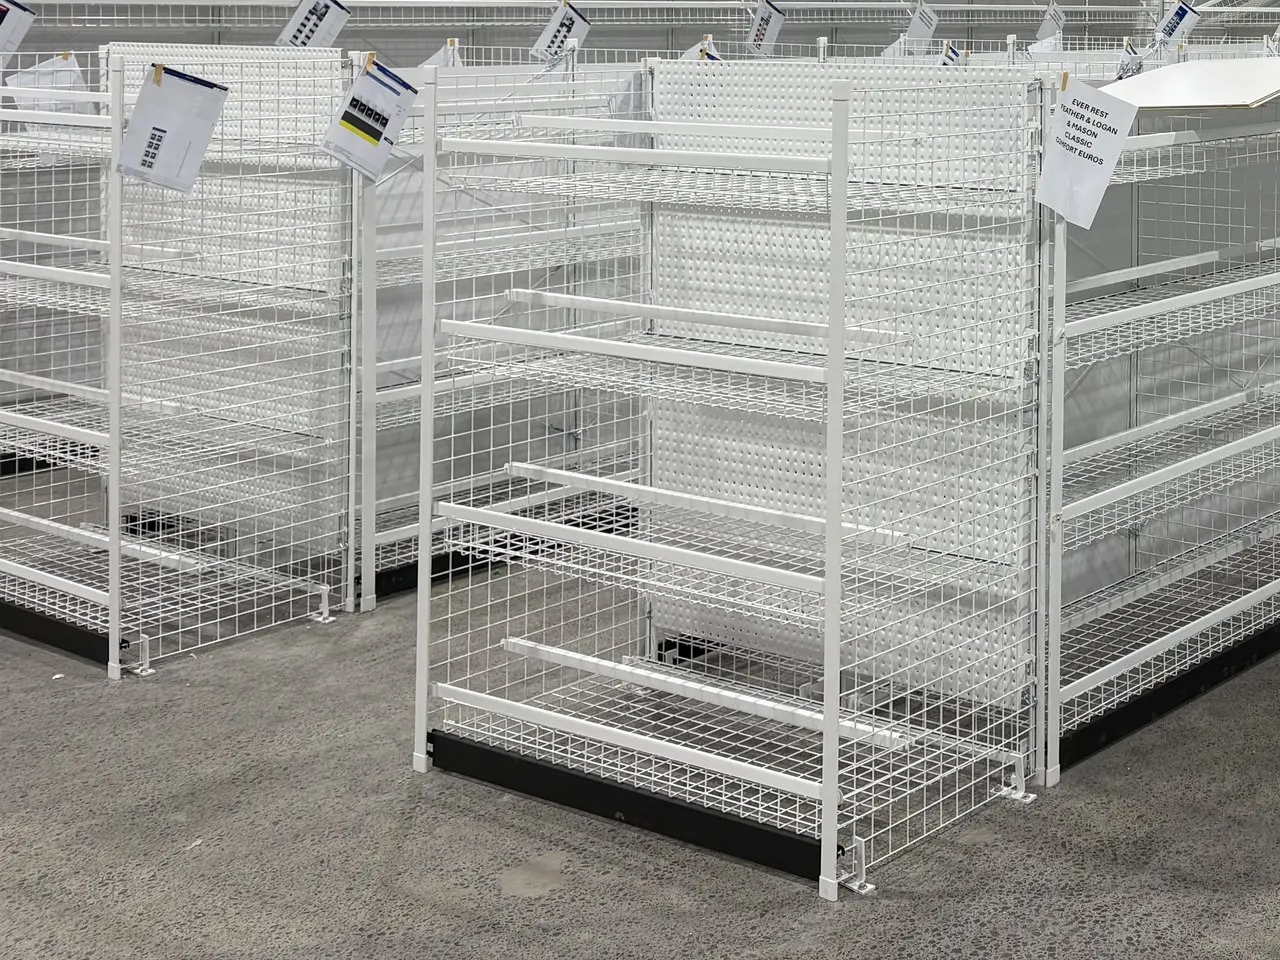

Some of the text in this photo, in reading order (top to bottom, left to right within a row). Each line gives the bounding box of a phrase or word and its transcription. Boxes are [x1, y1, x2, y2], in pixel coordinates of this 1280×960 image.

[1071, 98, 1109, 119] EVER REST
[1060, 103, 1119, 135] FEATHER & LOGAN
[1066, 120, 1098, 139] & MASON
[1064, 131, 1093, 149] CLASSIC
[1078, 150, 1104, 166] EUROS
